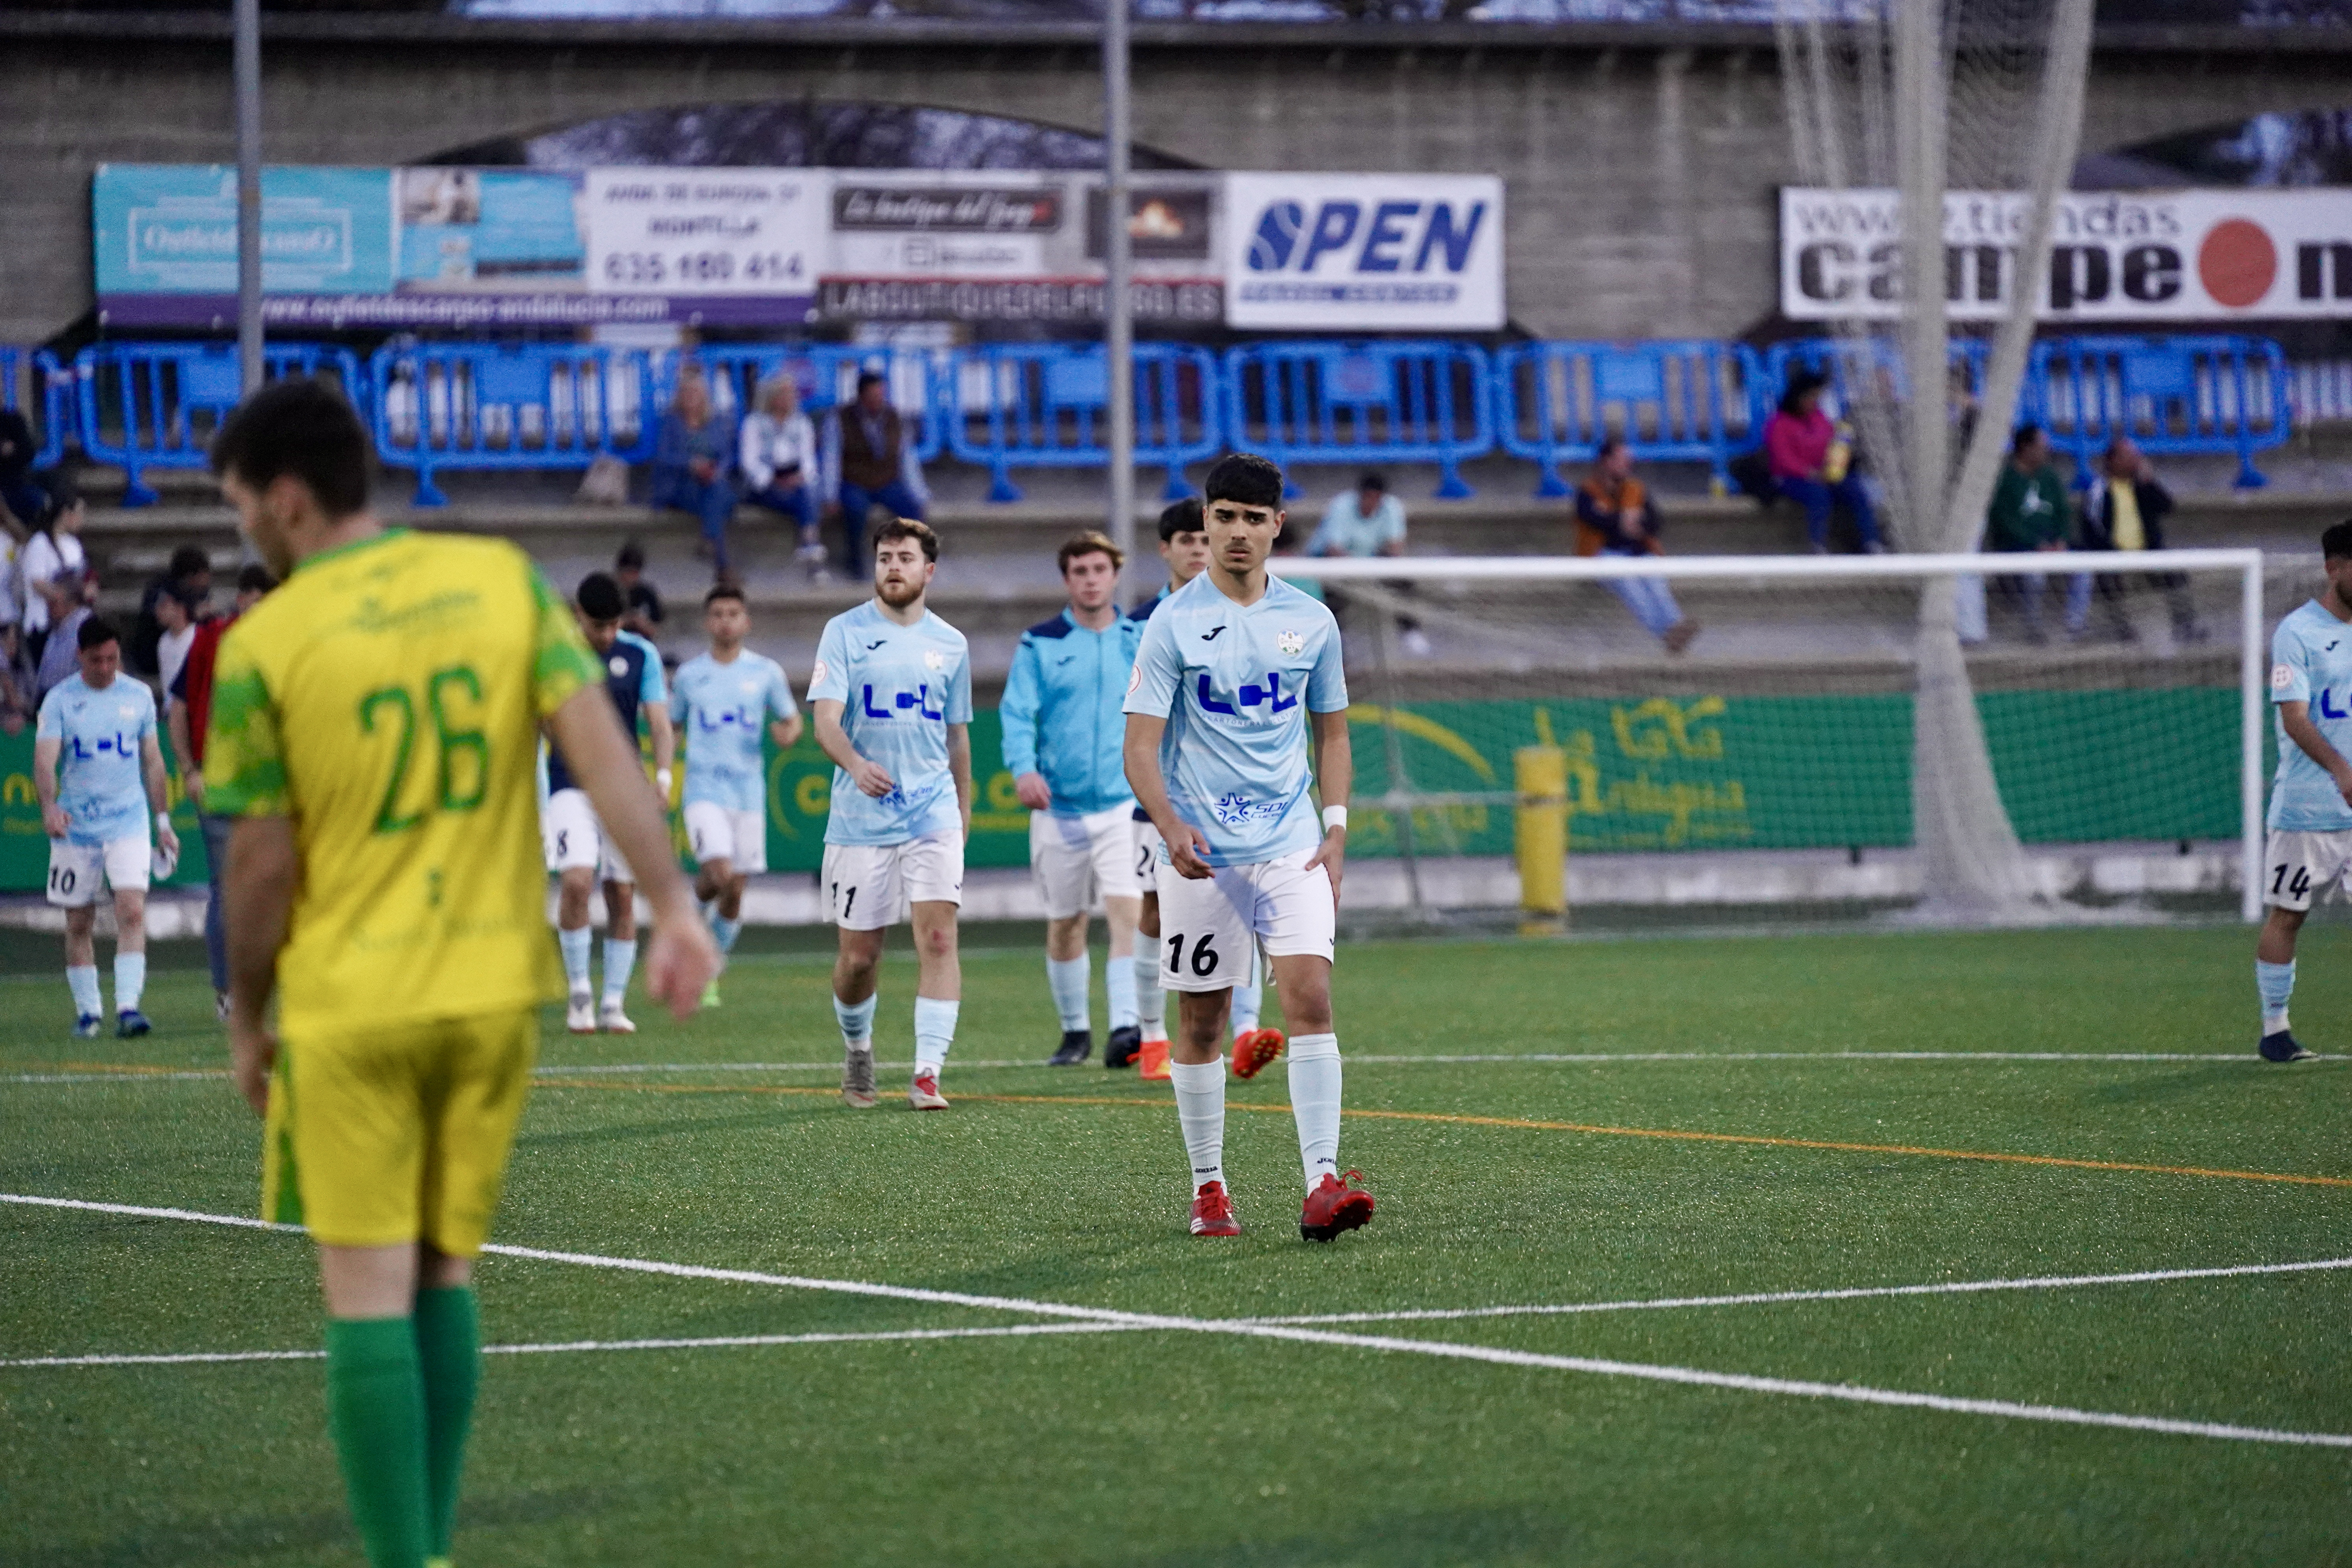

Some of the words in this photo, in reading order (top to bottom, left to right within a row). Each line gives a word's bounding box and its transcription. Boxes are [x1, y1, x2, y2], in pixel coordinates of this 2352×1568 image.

[647, 215, 762, 238] MONTILLA
[358, 664, 490, 835] 26
[51, 864, 76, 895] 10
[2273, 863, 2310, 901] 14
[831, 882, 857, 919] 11
[1168, 933, 1219, 976] 16
